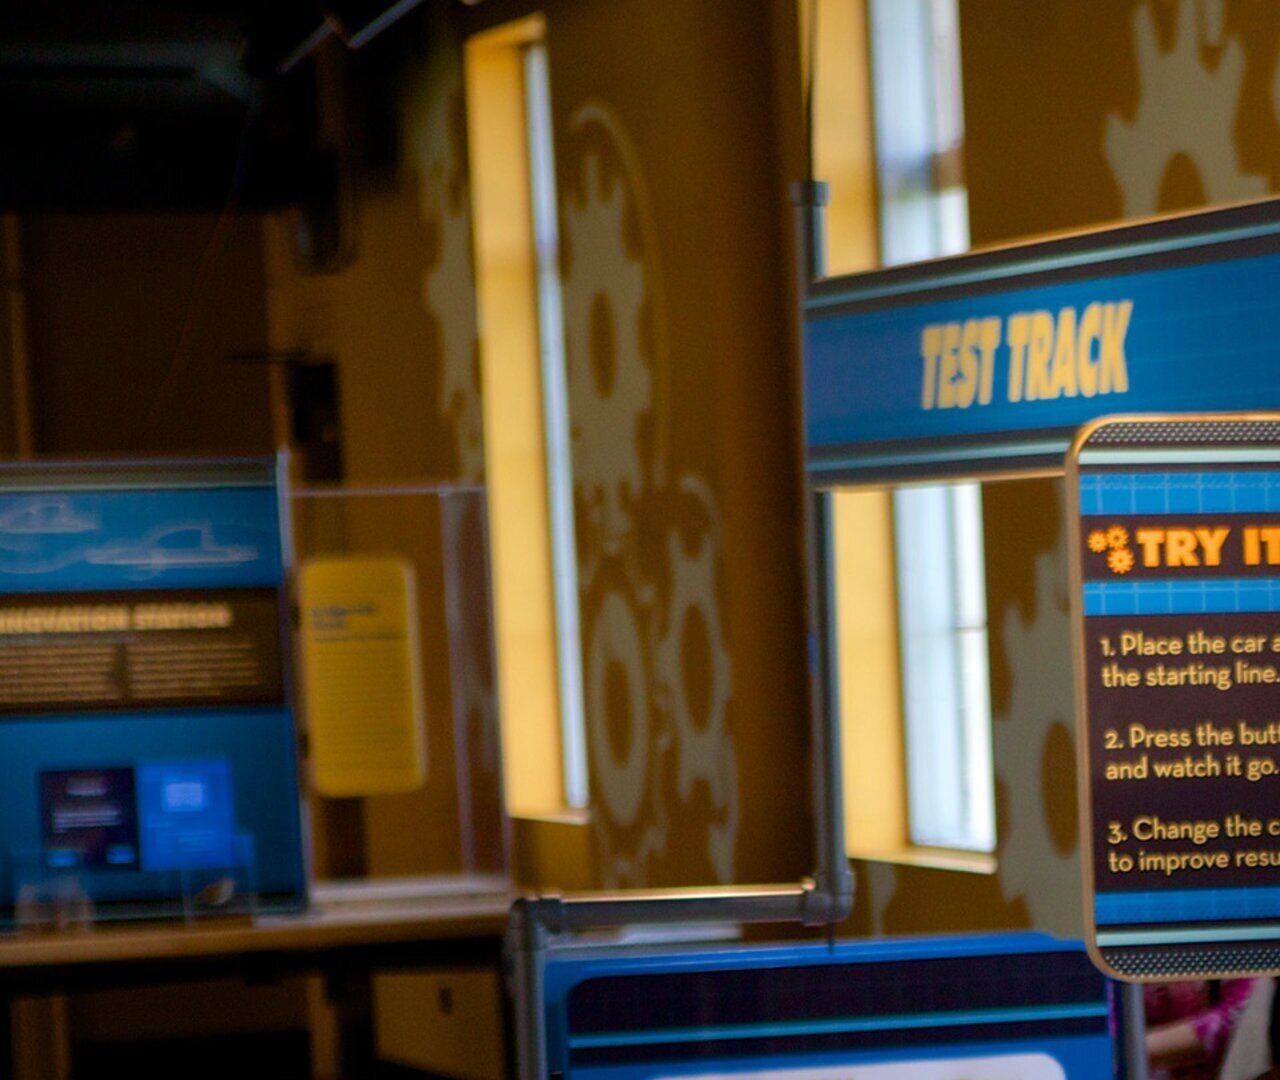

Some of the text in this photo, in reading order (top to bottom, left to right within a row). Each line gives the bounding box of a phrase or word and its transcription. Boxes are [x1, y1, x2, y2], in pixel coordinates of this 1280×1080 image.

[921, 299, 1135, 411] TEST TRACK
[1136, 527, 1230, 568] TRY
[1101, 637, 1116, 656] 1.
[1121, 633, 1183, 656] Place
[1187, 631, 1226, 654] the
[1231, 635, 1266, 653] car
[1102, 663, 1140, 687] the
[1146, 664, 1232, 690] starting
[1105, 729, 1124, 749] 2.
[1130, 724, 1192, 748] Press
[1196, 723, 1233, 746] the
[1106, 754, 1280, 781] and watch it go.
[1108, 821, 1128, 844] 3.
[1133, 815, 1219, 844] Change
[1225, 814, 1262, 837] the
[1109, 852, 1133, 873] to
[1139, 851, 1229, 876] improve
